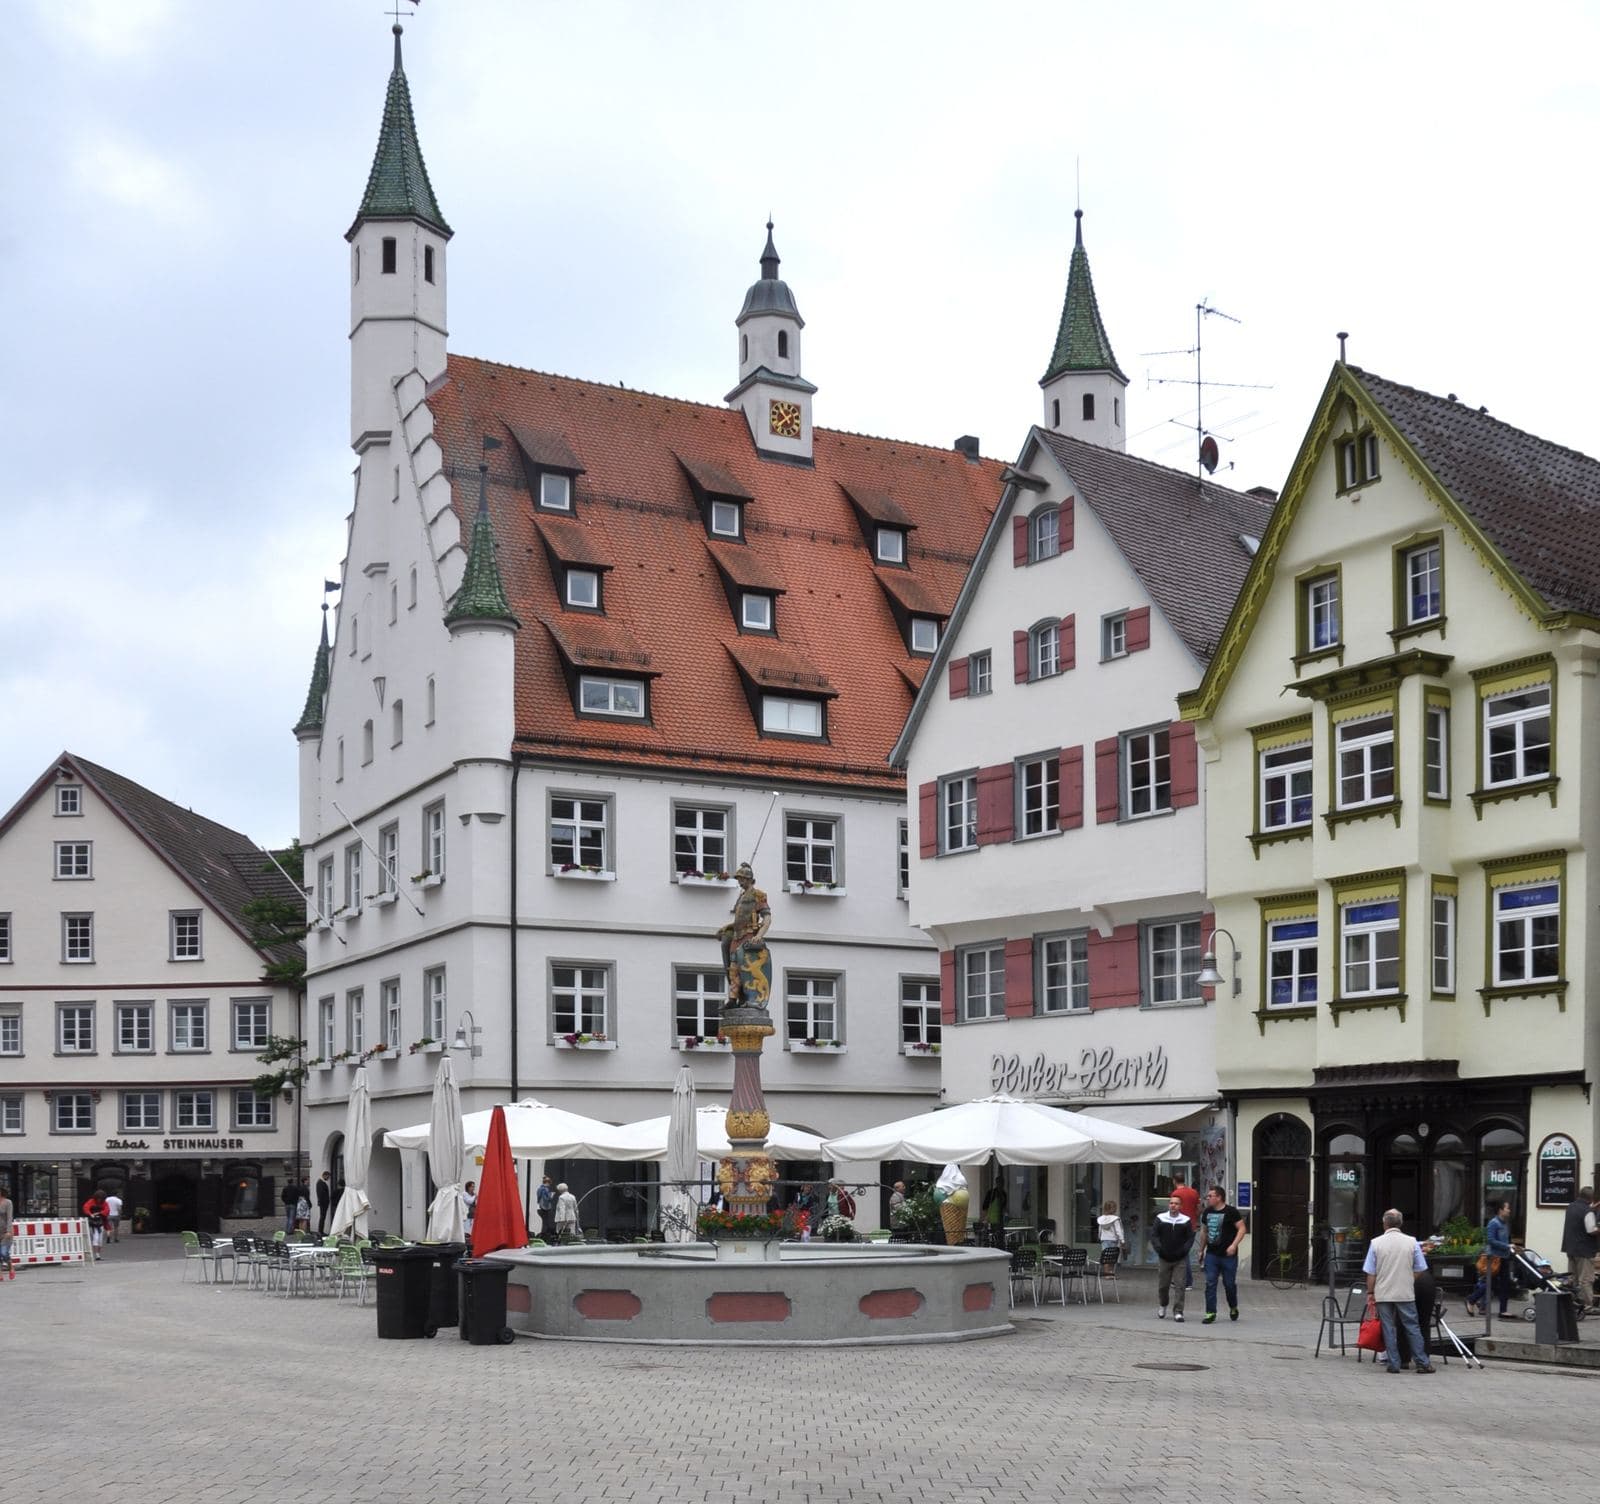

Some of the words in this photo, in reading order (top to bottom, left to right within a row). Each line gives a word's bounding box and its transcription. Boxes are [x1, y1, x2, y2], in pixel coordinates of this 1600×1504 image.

[991, 1045, 1168, 1093] Huber-Harth
[106, 1139, 150, 1150] Tabak
[163, 1138, 244, 1149] STEINHAUSER
